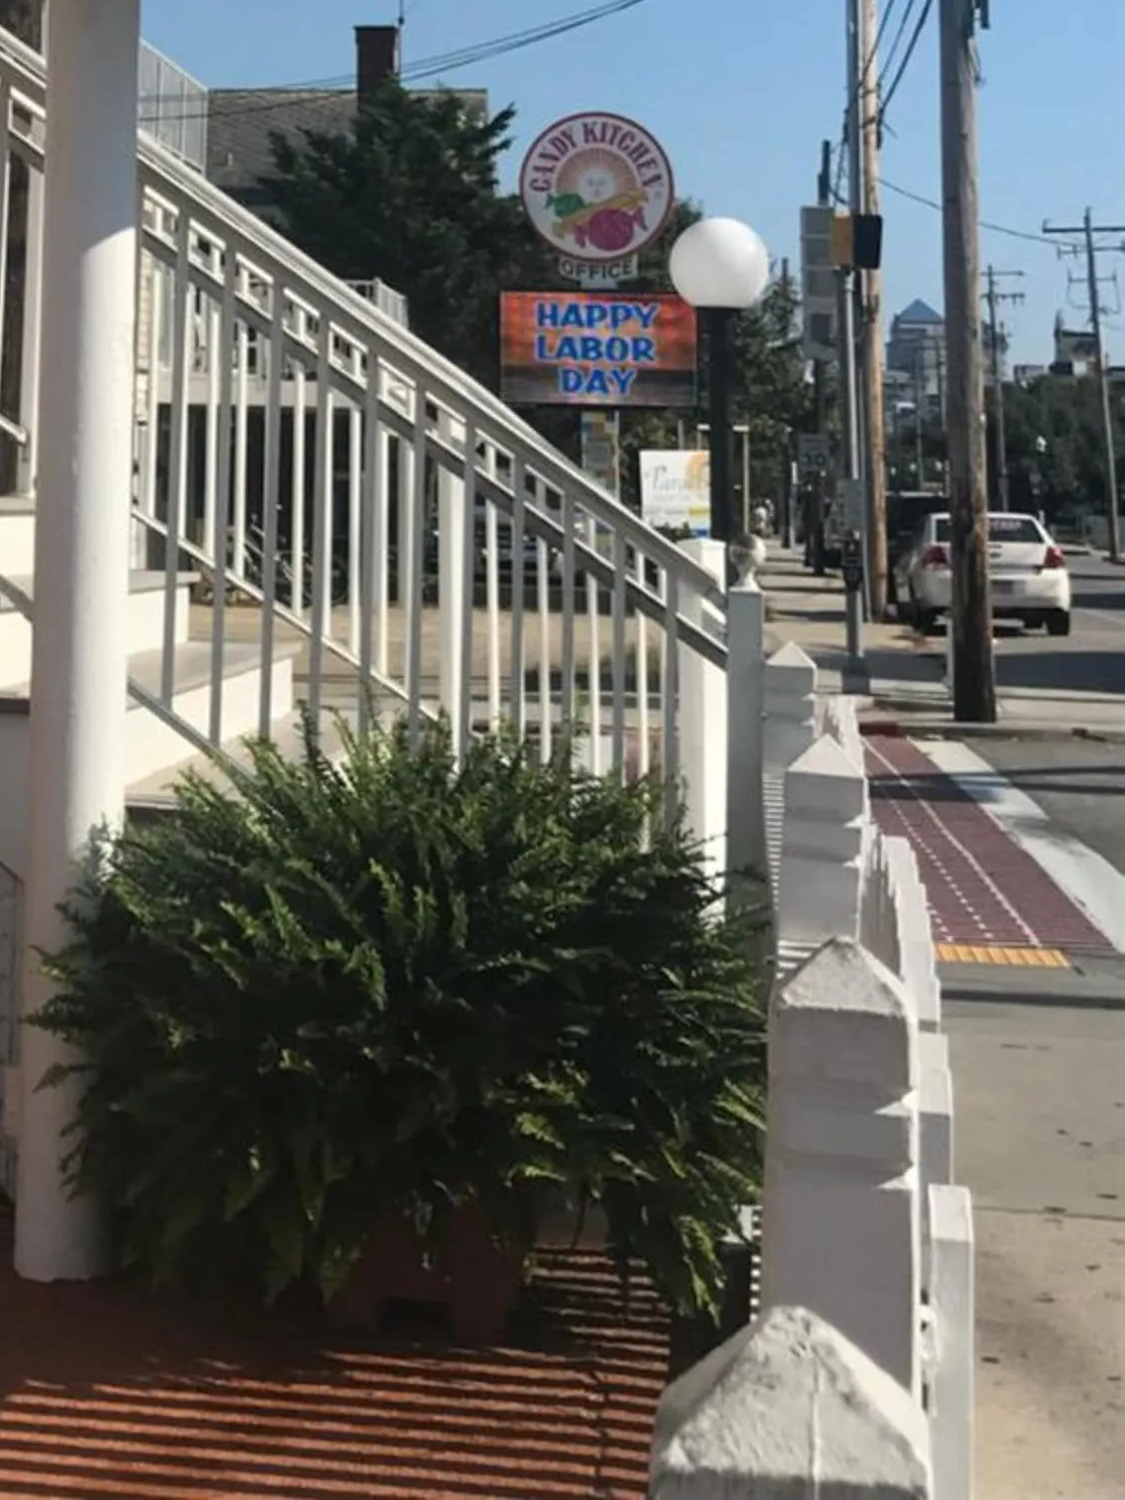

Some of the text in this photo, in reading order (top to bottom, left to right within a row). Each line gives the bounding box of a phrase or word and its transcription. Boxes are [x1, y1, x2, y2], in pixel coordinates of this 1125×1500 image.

[529, 120, 663, 193] CANDY KITCHEN
[560, 257, 634, 280] OFFICE
[535, 301, 659, 330] HAPPY
[535, 334, 656, 363] LABOR
[558, 367, 636, 396] DAY
